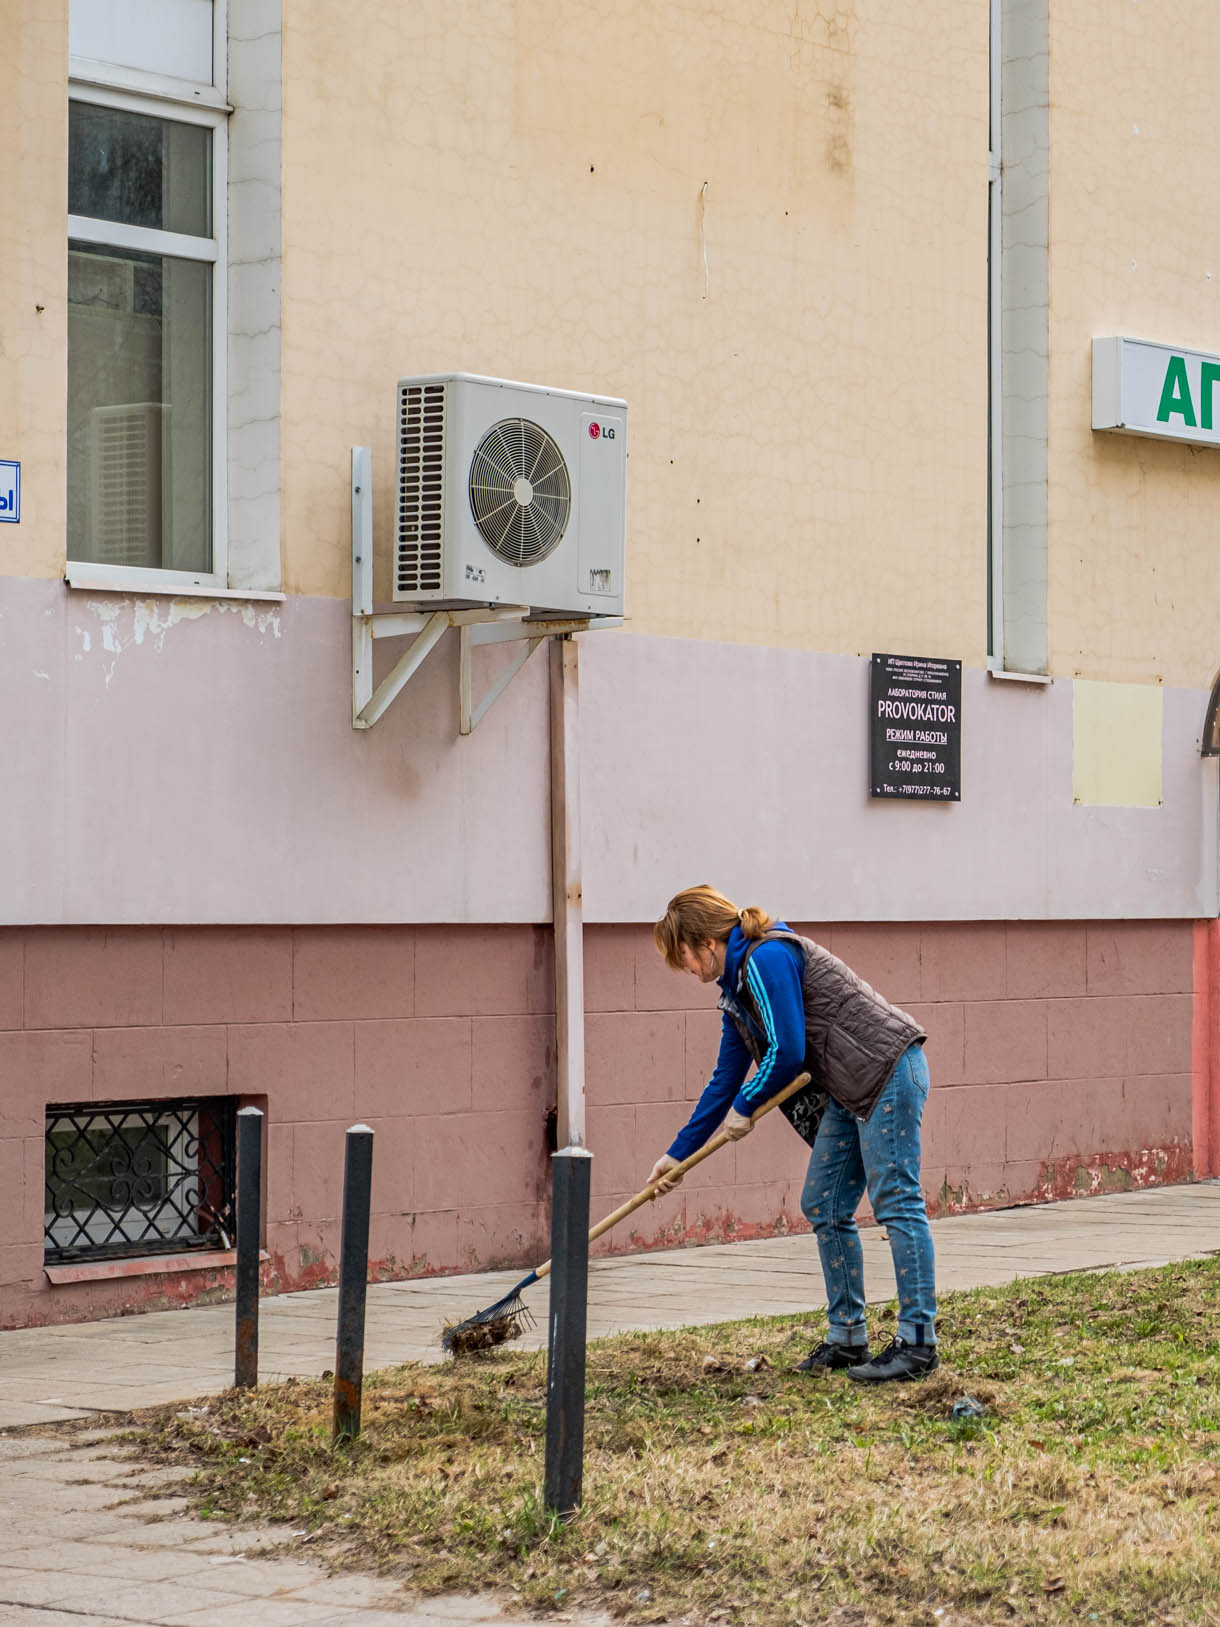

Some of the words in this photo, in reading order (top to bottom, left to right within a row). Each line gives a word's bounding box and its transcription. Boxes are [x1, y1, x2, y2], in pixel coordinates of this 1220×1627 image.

[602, 427, 615, 440] LG
[888, 688, 927, 699] ЛАБОРАТОРИЯ
[927, 689, 947, 701] СТИЛЯ
[878, 700, 956, 723] PROVOKATOR
[886, 728, 914, 741] РЕЖИМ
[916, 730, 948, 743] РАБОТЫ
[897, 749, 937, 760] ежедневно
[895, 760, 911, 771] 9:00
[912, 764, 922, 773] до
[923, 762, 945, 774] 21:00
